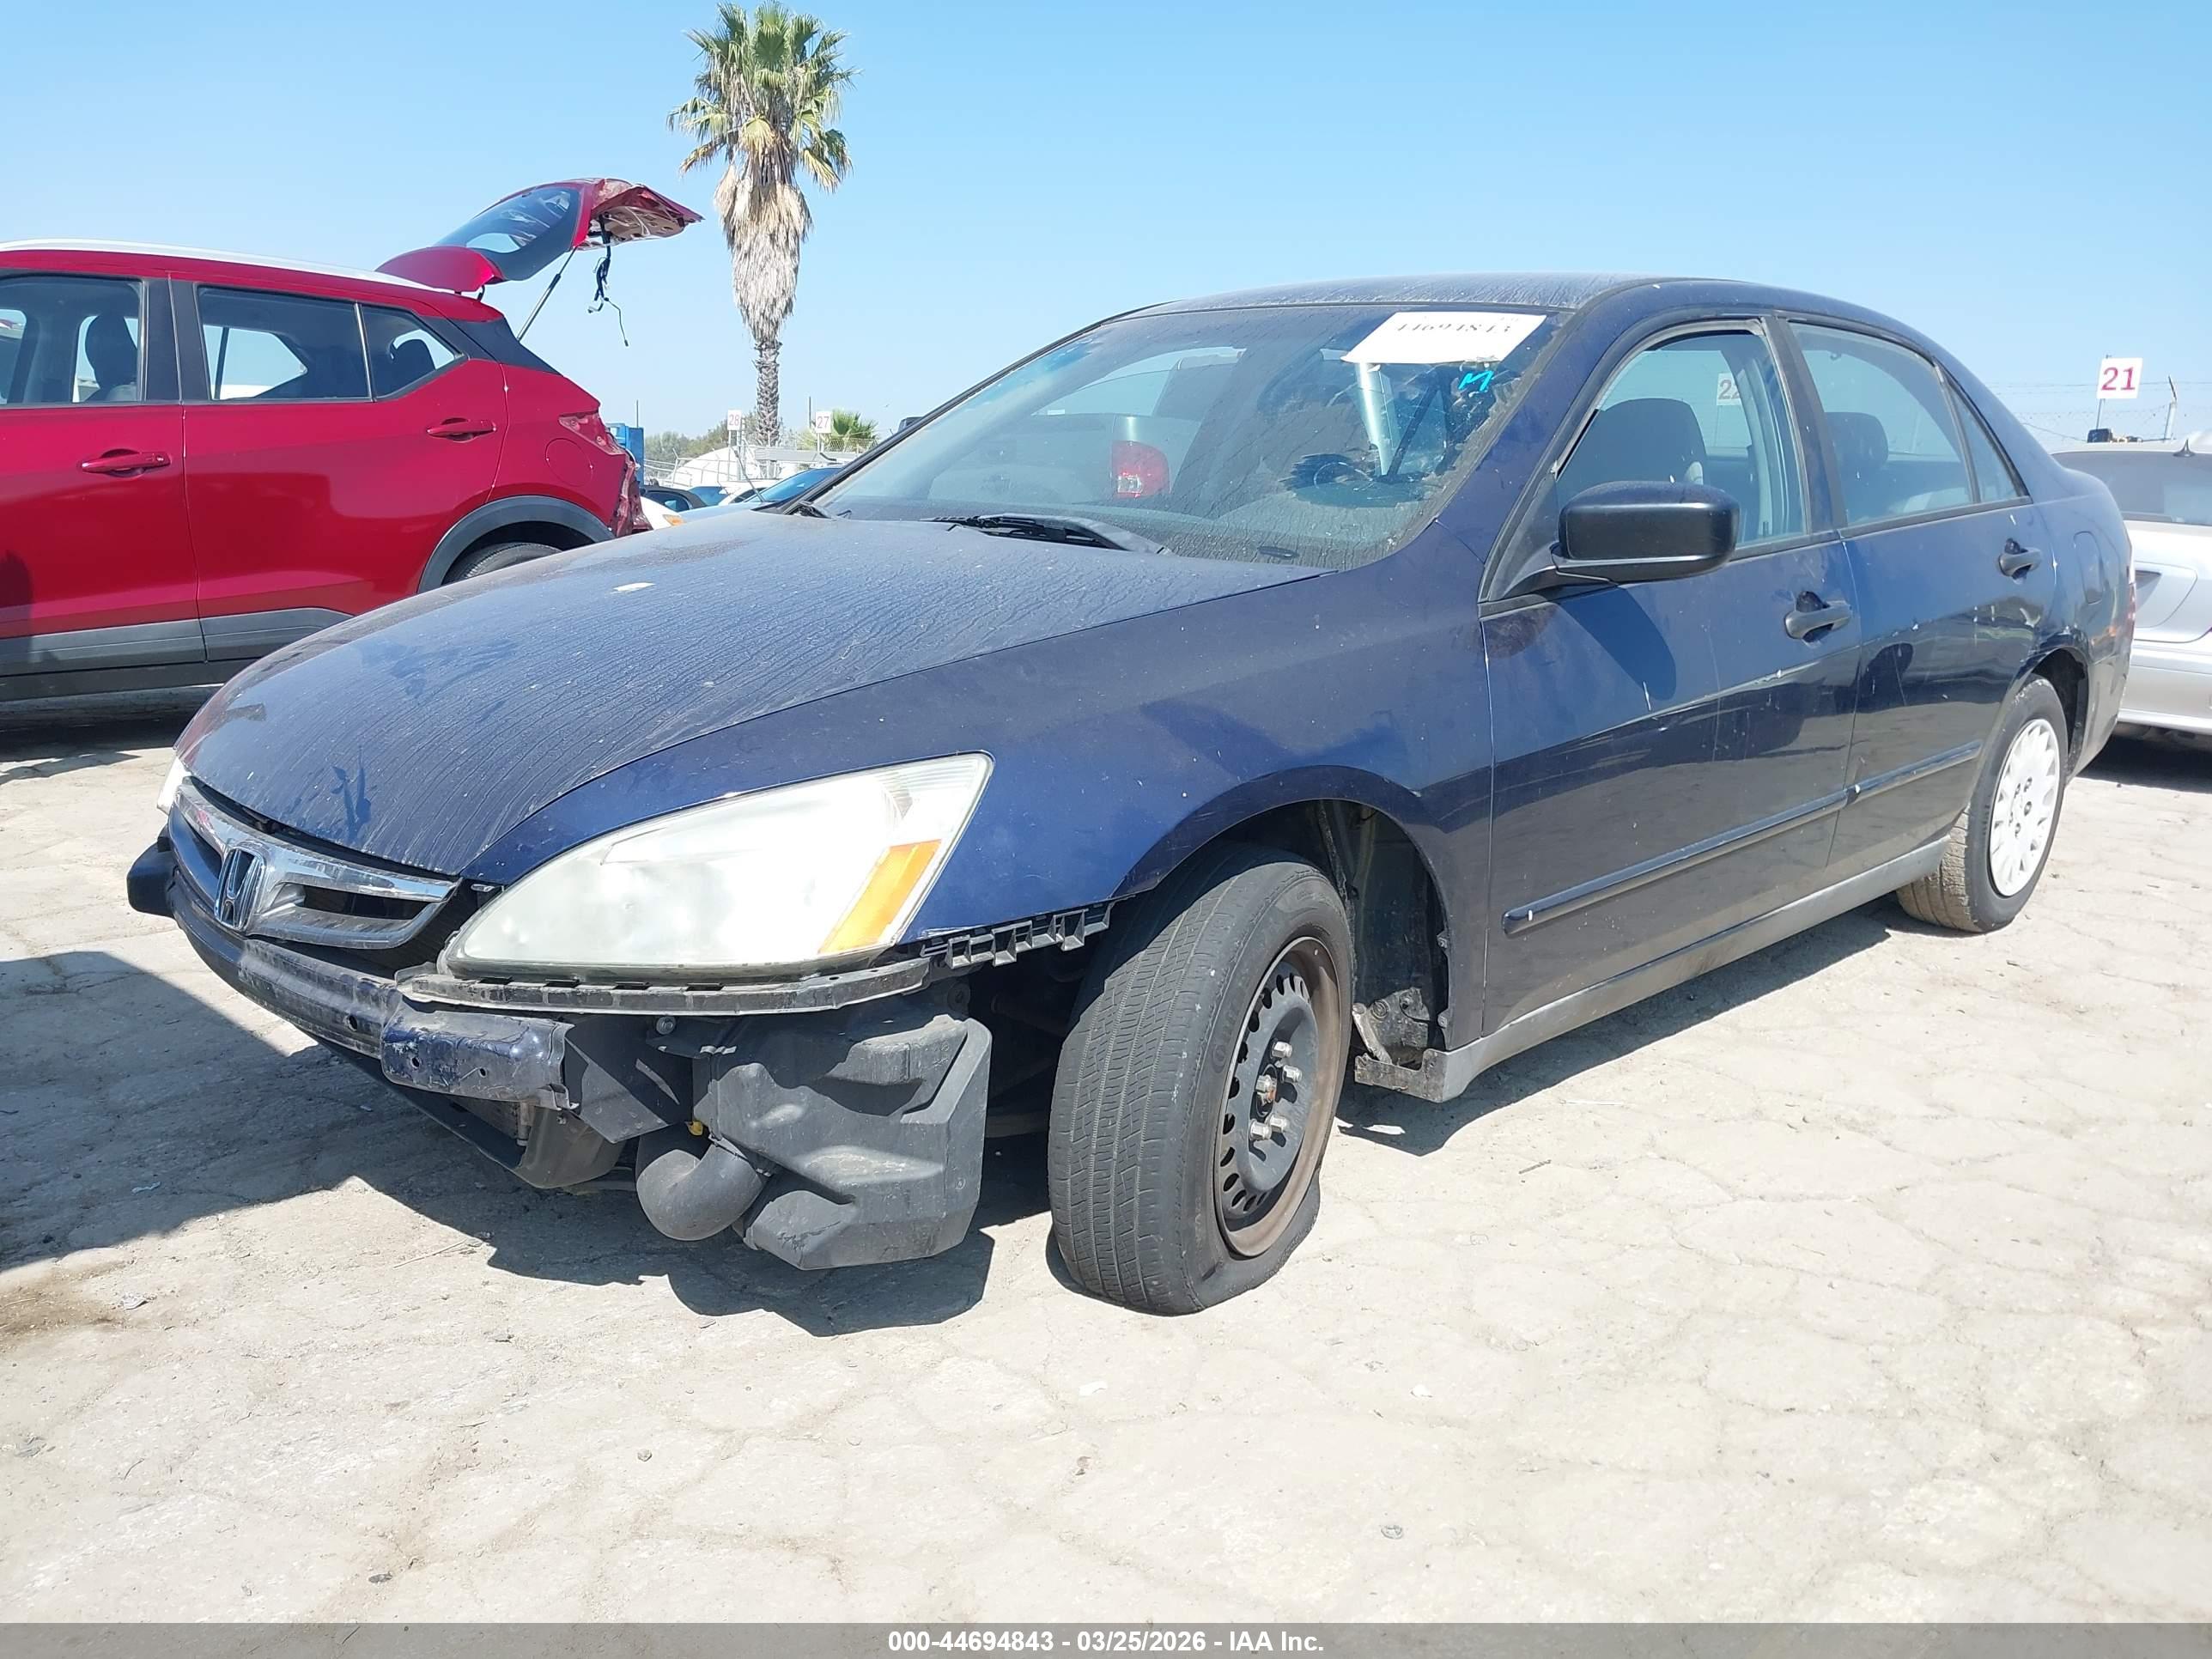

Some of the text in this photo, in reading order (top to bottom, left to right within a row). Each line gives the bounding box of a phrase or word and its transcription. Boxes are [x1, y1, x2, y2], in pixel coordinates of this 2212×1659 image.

[2101, 367, 2136, 391] 21
[729, 414, 739, 427] 28
[817, 416, 830, 429] 27
